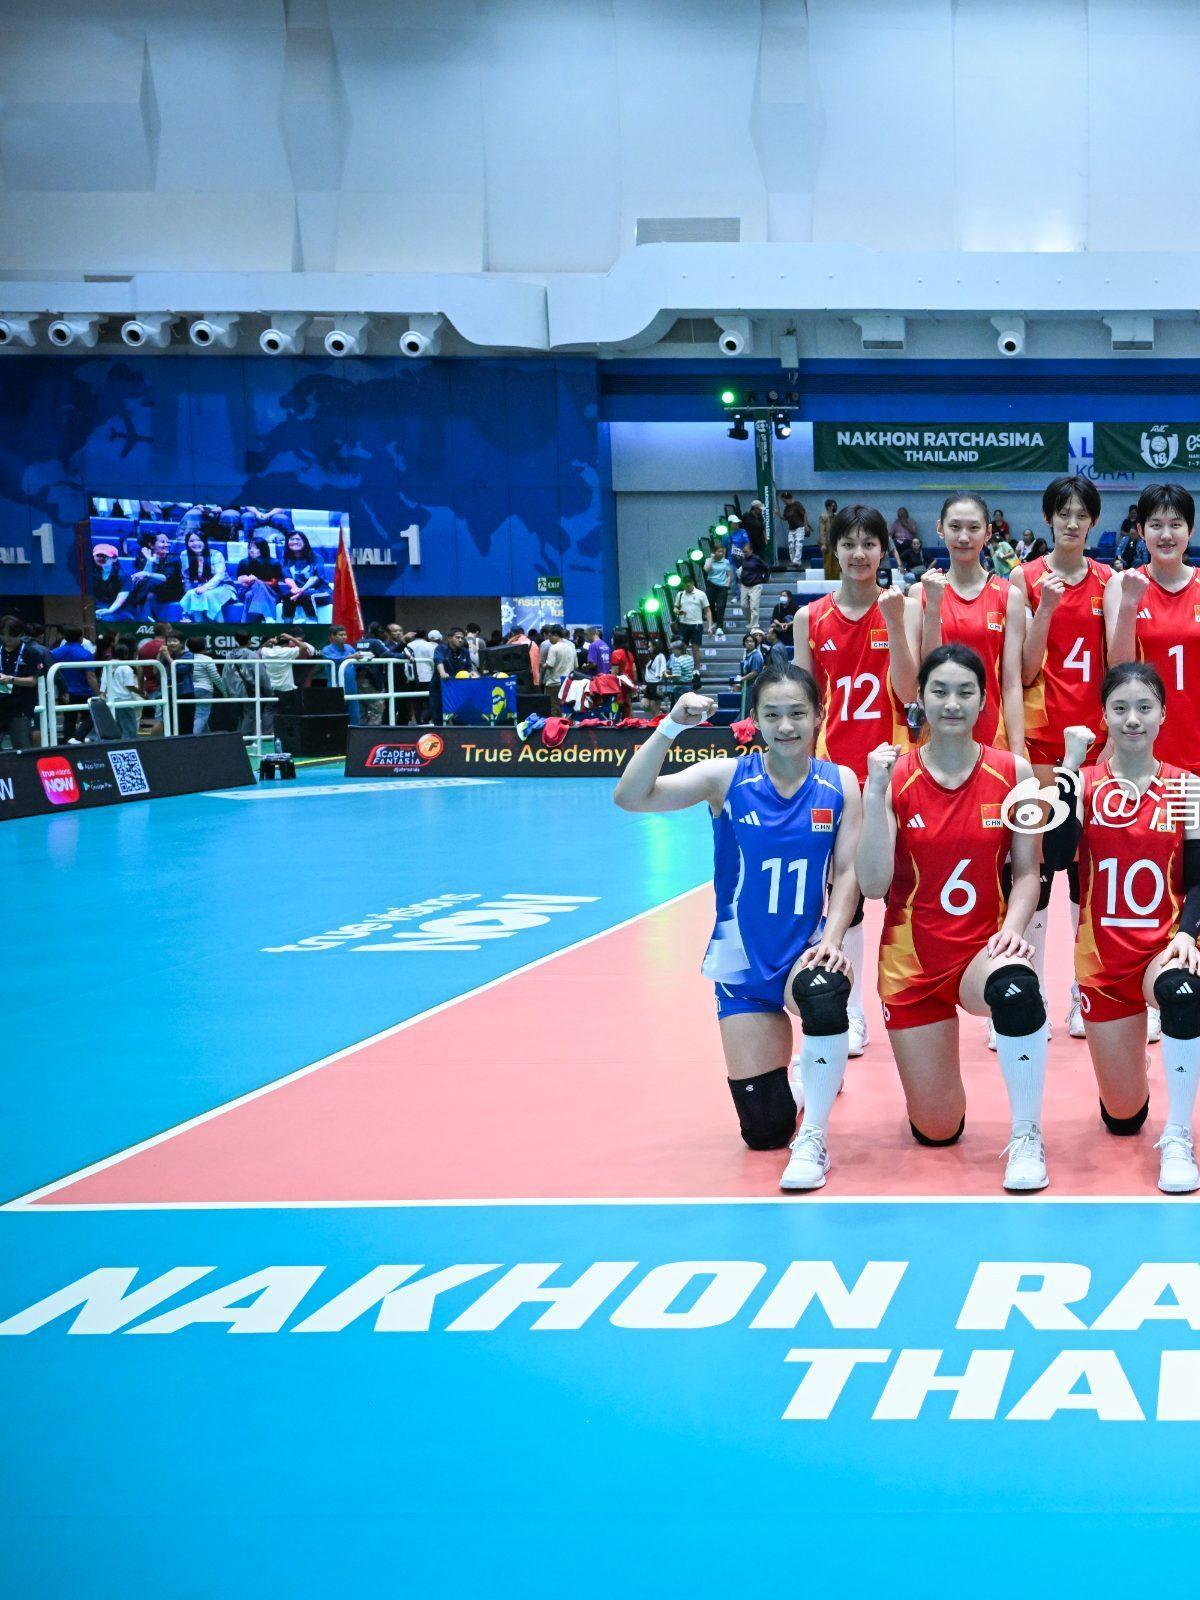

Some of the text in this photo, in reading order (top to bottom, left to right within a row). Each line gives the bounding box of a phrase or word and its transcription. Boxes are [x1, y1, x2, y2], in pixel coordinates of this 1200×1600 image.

[837, 431, 1045, 447] NAKHON RATCHASIMA
[904, 450, 979, 462] THAILAND
[1152, 453, 1167, 465] 18
[32, 523, 56, 564] 1
[351, 525, 421, 565] HALL 1
[1063, 637, 1091, 682] 4
[1168, 645, 1184, 690] 1
[836, 673, 882, 722] 12
[376, 749, 416, 758] ACADEMY
[461, 744, 512, 763] True
[518, 743, 627, 767] Academy
[634, 744, 728, 763] ntasia
[44, 777, 74, 793] NOW
[761, 858, 808, 915] 11
[940, 858, 976, 916] 6
[1098, 858, 1164, 916] 10
[348, 894, 602, 952] NOW
[0, 1261, 909, 1336] NAKHON
